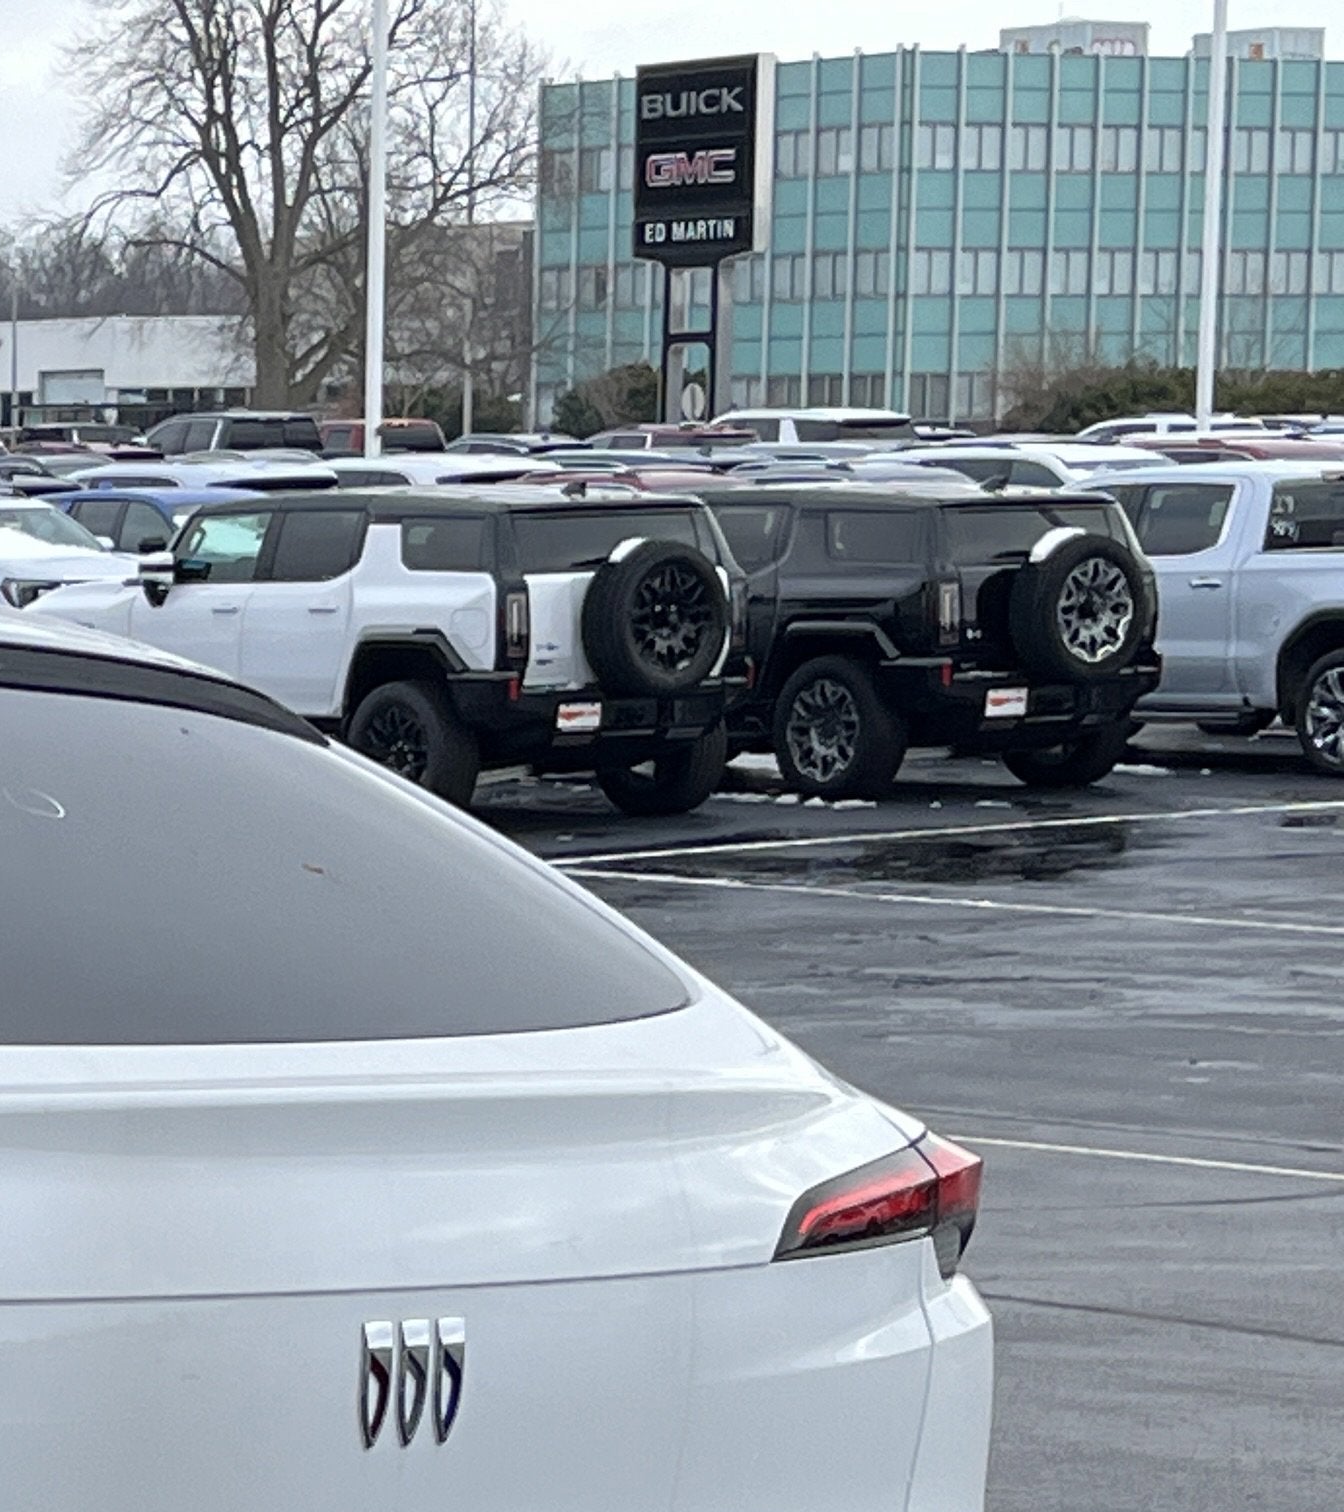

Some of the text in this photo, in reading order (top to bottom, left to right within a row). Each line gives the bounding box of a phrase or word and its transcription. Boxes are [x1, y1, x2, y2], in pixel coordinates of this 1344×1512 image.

[641, 87, 744, 119] BUICK
[646, 148, 737, 187] GMC
[644, 218, 735, 243] ED MARTIN
